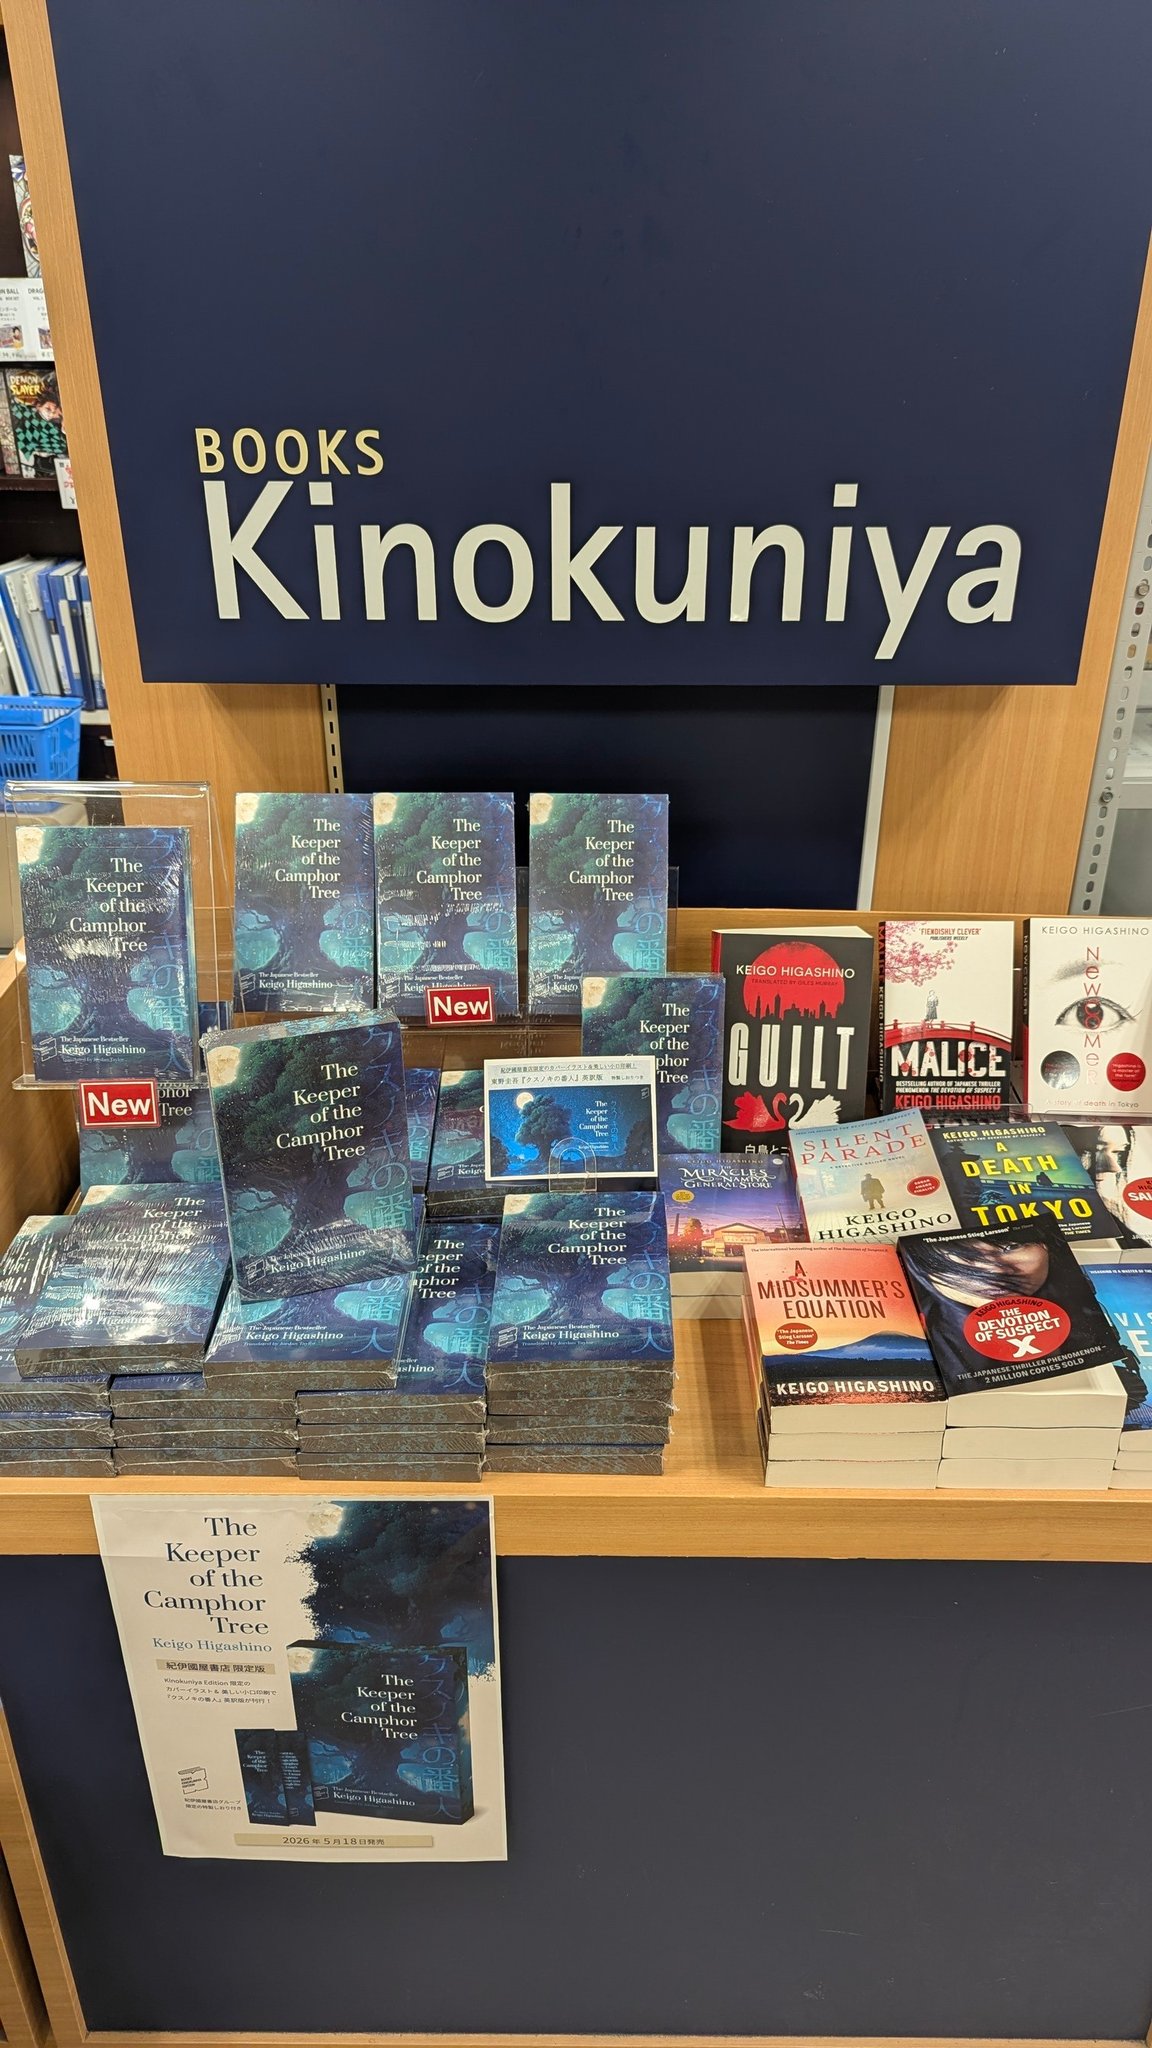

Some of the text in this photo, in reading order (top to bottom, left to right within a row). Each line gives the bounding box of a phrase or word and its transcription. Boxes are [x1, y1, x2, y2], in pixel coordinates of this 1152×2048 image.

[10, 375, 40, 386] DEMON
[11, 384, 41, 396] SLAYER
[194, 427, 386, 477] BOOKS
[202, 480, 1023, 661] Kinokuniya
[313, 818, 341, 832] The
[453, 818, 481, 832] The
[607, 819, 635, 833] The
[291, 835, 341, 852] Keeper
[431, 836, 481, 852] Keeper
[585, 837, 635, 854] Keeper
[110, 857, 143, 873] The
[301, 852, 341, 866] of the
[442, 853, 482, 867] of the
[595, 854, 635, 868] of the
[274, 868, 341, 886] Camphor
[416, 870, 482, 888] Camphor
[568, 871, 635, 889] Camphor
[86, 877, 145, 896] Keeper
[308, 885, 341, 899] Tree
[449, 887, 483, 901] Tree
[602, 888, 634, 901] Tree
[99, 898, 146, 913] of the
[70, 917, 147, 934] Camphor
[1041, 926, 1150, 936] KEIGO HIGASHINO
[110, 937, 148, 952] Tree
[735, 964, 856, 979] KEIGO HIGASHINO
[259, 979, 333, 990] Keigo Higashino
[433, 996, 489, 1017] New
[662, 1003, 690, 1017] The
[639, 1020, 690, 1037] Keeper
[60, 1043, 146, 1057] Keigo Higashino
[650, 1037, 690, 1050] of the
[728, 1022, 856, 1091] GUILT
[890, 1040, 1007, 1078] MALICE
[321, 1062, 359, 1081] The
[656, 1070, 689, 1084] Tree
[87, 1091, 152, 1117] New
[293, 1084, 361, 1108] Keeper
[895, 1094, 1001, 1110] KEIGO HIGASHINO
[1083, 1100, 1106, 1108] death
[159, 1103, 193, 1117] Tree
[310, 1105, 363, 1125] of the
[585, 1108, 608, 1116] Keeper
[579, 1123, 609, 1132] Camphor
[942, 1126, 1047, 1140] KEIGO HIGASHINO
[276, 1123, 364, 1150] Camphor
[803, 1123, 914, 1152] SILENT
[323, 1144, 366, 1162] Tree
[801, 1134, 927, 1166] PARADE
[996, 1141, 1008, 1153] A
[679, 1167, 769, 1179] MIRACLES
[960, 1154, 1059, 1178] DEATH
[684, 1181, 773, 1190] GENERAL STORE
[1009, 1182, 1032, 1196] IN
[174, 1197, 206, 1207] The
[143, 1208, 203, 1220] Keeper
[594, 1207, 627, 1218] The
[845, 1208, 917, 1226] KEIGO
[970, 1197, 1094, 1227] TOKYO
[568, 1219, 627, 1231] Keeper
[817, 1213, 953, 1241] HIGASHINO
[580, 1230, 627, 1241] of the
[938, 1232, 967, 1243] Japanese
[968, 1231, 984, 1240] Stieg
[434, 1239, 465, 1250] The
[547, 1243, 627, 1256] Camphor
[270, 1248, 367, 1275] Keigo Higashino
[588, 1254, 627, 1266] Tree
[793, 1259, 807, 1277] A
[418, 1288, 457, 1299] Tree
[757, 1279, 906, 1300] MIDSUMMER'S
[783, 1300, 886, 1319] EQUATION
[975, 1298, 1044, 1318] KEIGO HIGASHINO
[999, 1307, 1021, 1318] THE
[977, 1309, 1051, 1332] DEVOTION
[245, 1331, 344, 1342] Keigo Higashino
[522, 1330, 620, 1342] Keigo Higashino
[975, 1317, 1061, 1343] OF SUSPECT
[1006, 1335, 1043, 1358] X
[957, 1345, 1102, 1381] THE JAPANESE THRILLER PHENOMENON
[985, 1357, 1085, 1384] 2 MILLION COPIES SOLD
[776, 1380, 935, 1396] KEIGO HIGASHINO
[204, 1517, 258, 1537] The
[164, 1542, 261, 1568] Keeper
[189, 1568, 264, 1588] of the
[143, 1589, 267, 1616] Camphor
[209, 1616, 270, 1635] Tree
[152, 1637, 273, 1653] Keigo Higashino
[232, 1664, 266, 1674] 限定版
[381, 1673, 414, 1687] The
[356, 1686, 416, 1702] Keeper
[370, 1701, 416, 1714] of the
[340, 1711, 418, 1728] Camphor
[380, 1727, 419, 1740] Tree
